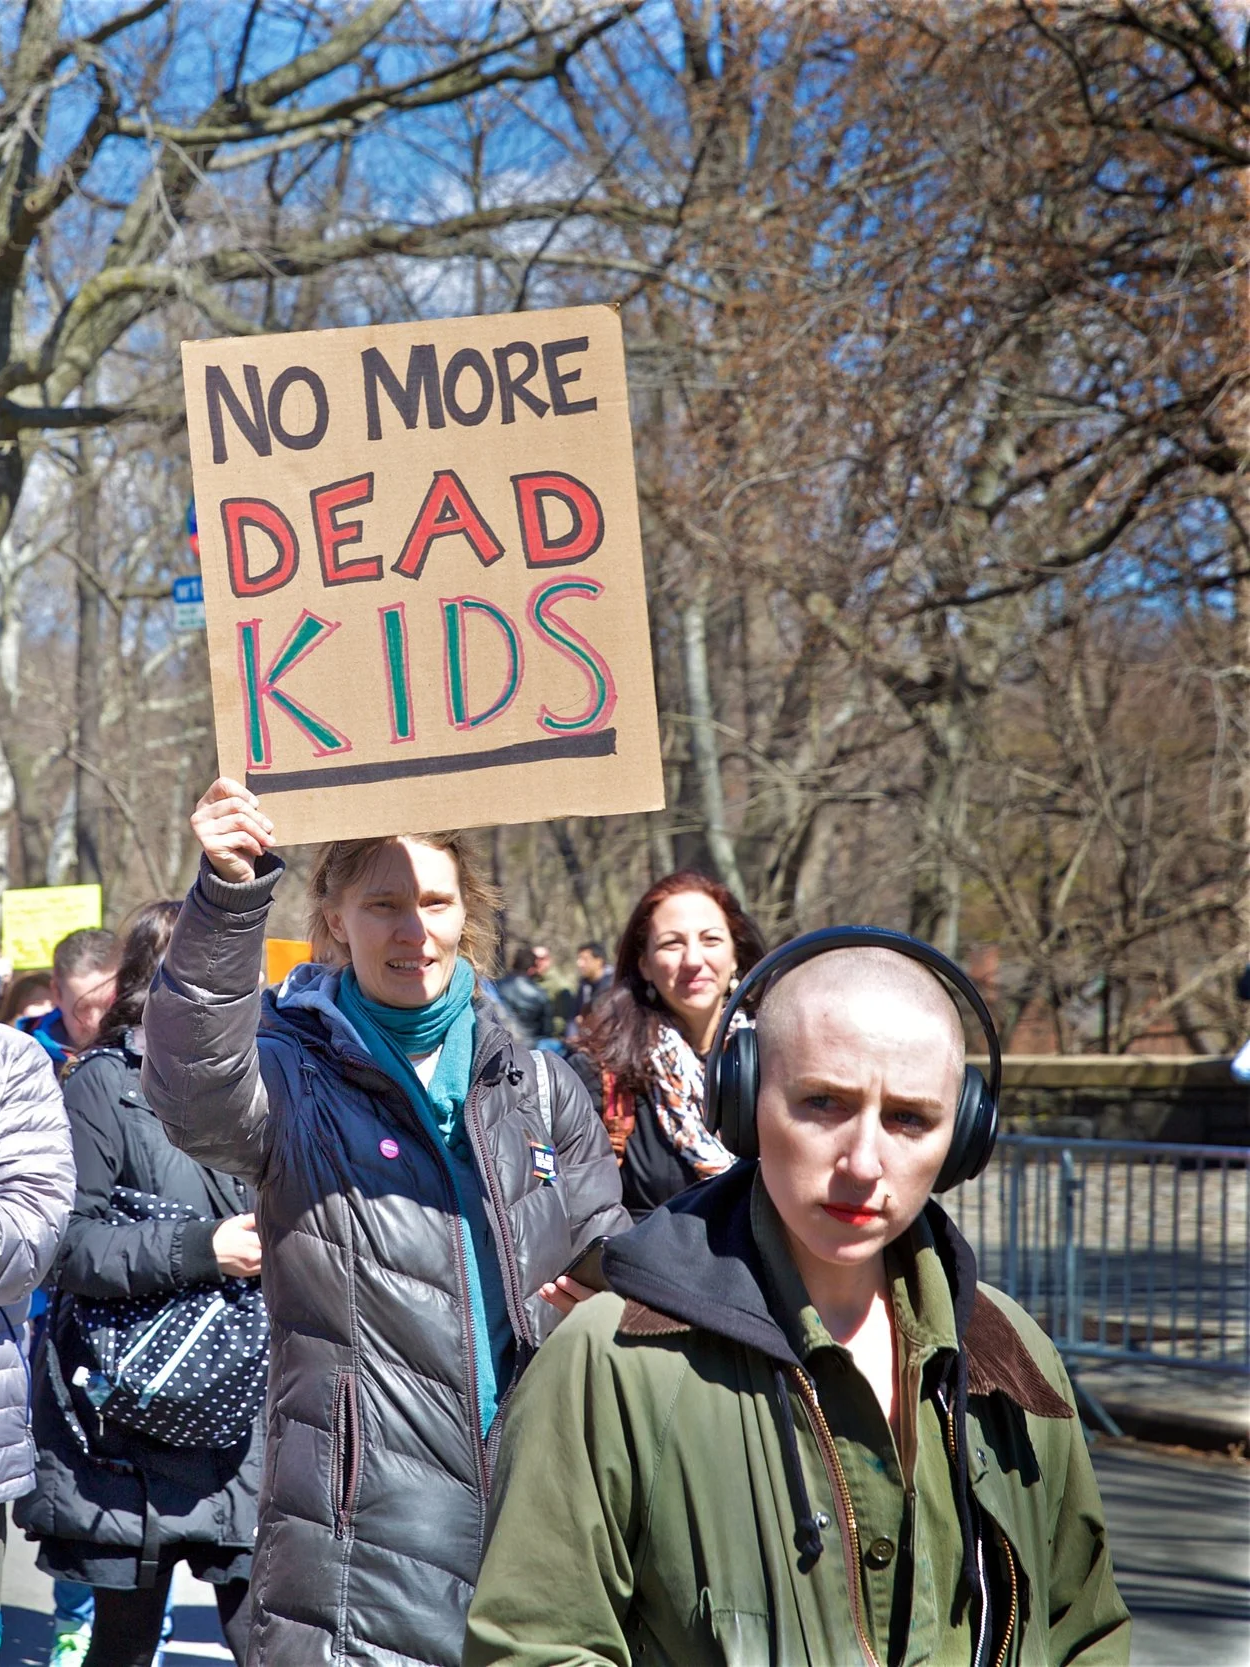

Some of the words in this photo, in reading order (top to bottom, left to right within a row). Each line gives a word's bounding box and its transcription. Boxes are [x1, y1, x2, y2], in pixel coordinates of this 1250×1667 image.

[205, 364, 330, 464] NO
[361, 336, 598, 441] MORE
[220, 469, 605, 598] DEAD
[236, 574, 618, 770] KIDS
